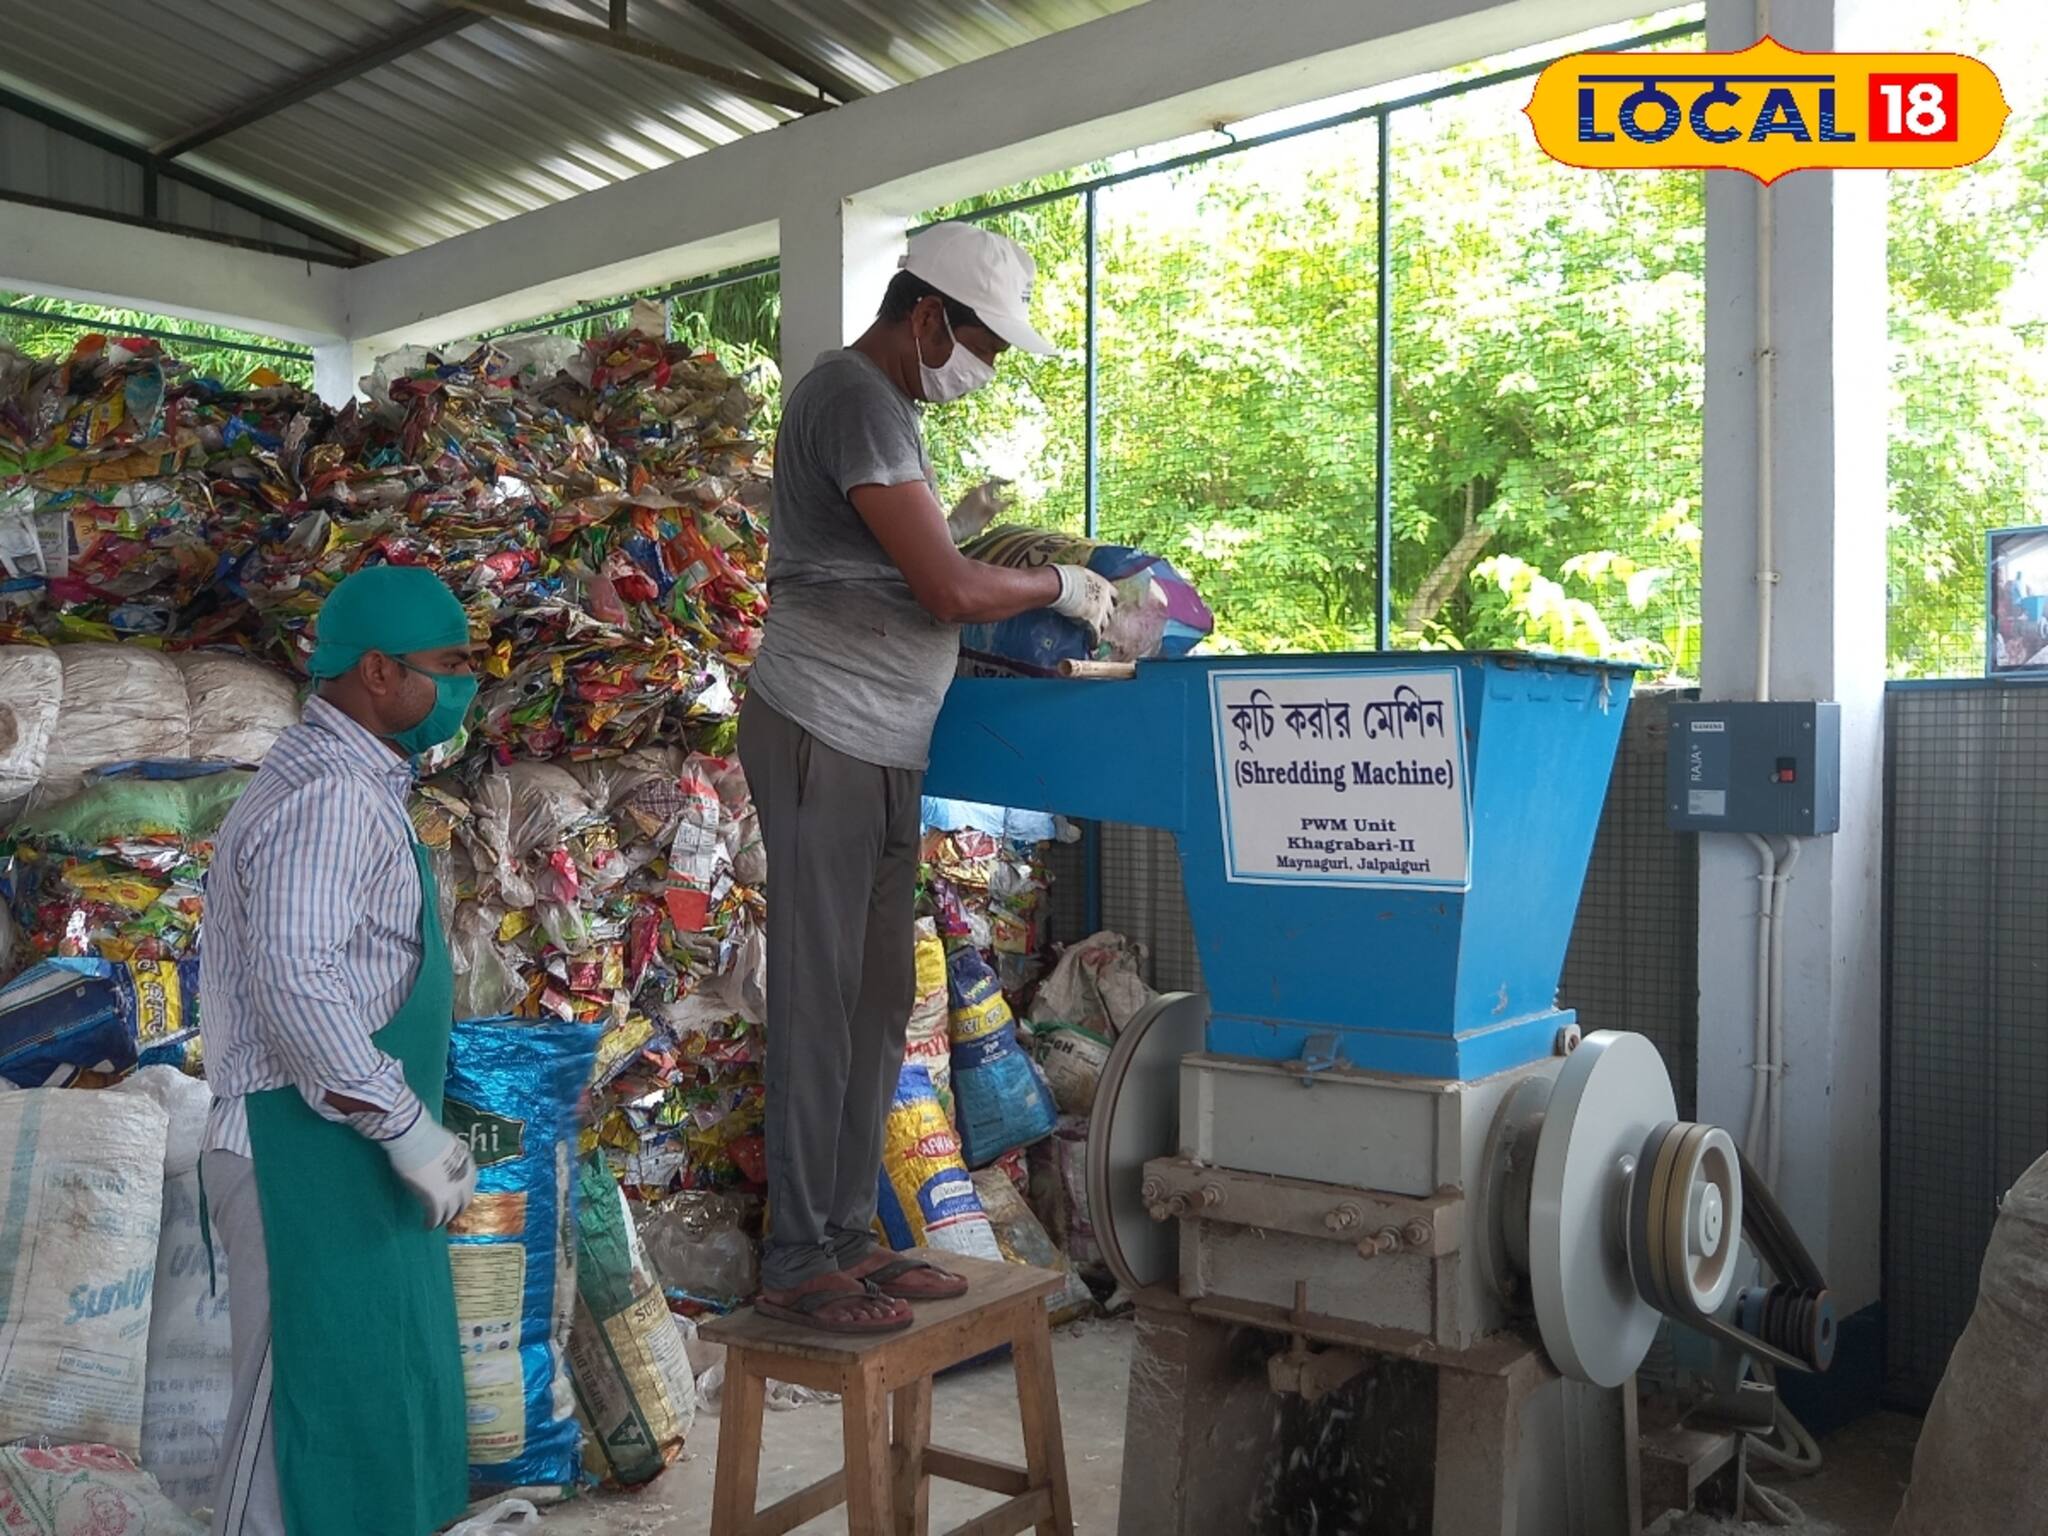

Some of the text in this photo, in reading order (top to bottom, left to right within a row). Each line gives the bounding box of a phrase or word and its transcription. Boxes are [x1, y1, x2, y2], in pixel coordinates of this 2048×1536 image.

[1227, 685, 1445, 752] কুচি করার মেশিন
[1234, 759, 1454, 792] (Shredding Machine)
[1301, 818, 1396, 832] PWM Unit
[1287, 836, 1415, 854] Khagrabari-II
[1357, 856, 1431, 875] Jalpaiguri
